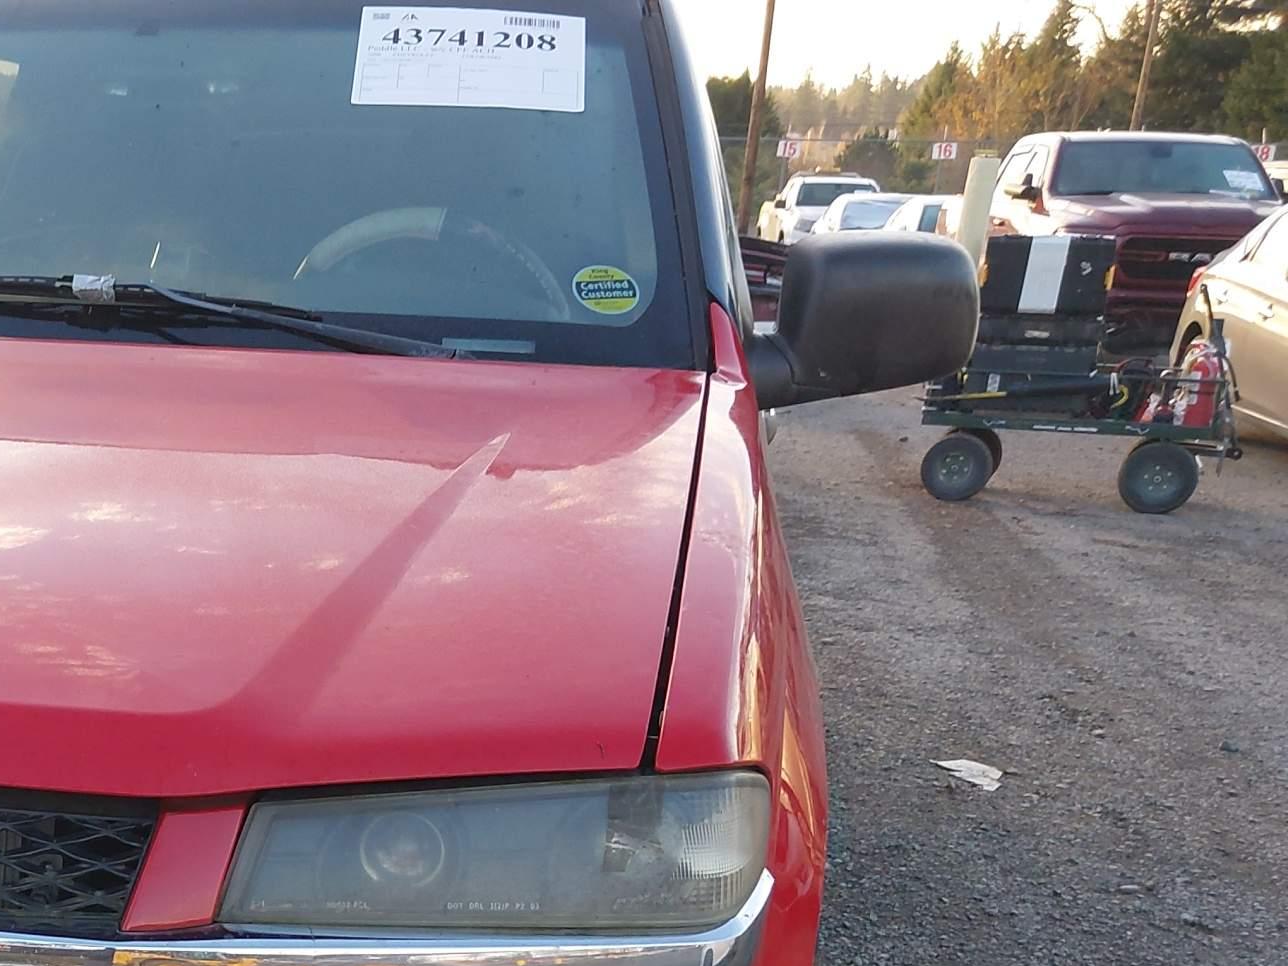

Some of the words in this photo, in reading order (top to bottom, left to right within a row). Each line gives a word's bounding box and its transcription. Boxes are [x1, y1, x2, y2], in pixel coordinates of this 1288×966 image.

[382, 27, 558, 52] 43741208
[783, 141, 797, 156] 15
[937, 143, 953, 158] 16
[580, 280, 629, 290] Certified
[581, 290, 634, 299] Customer
